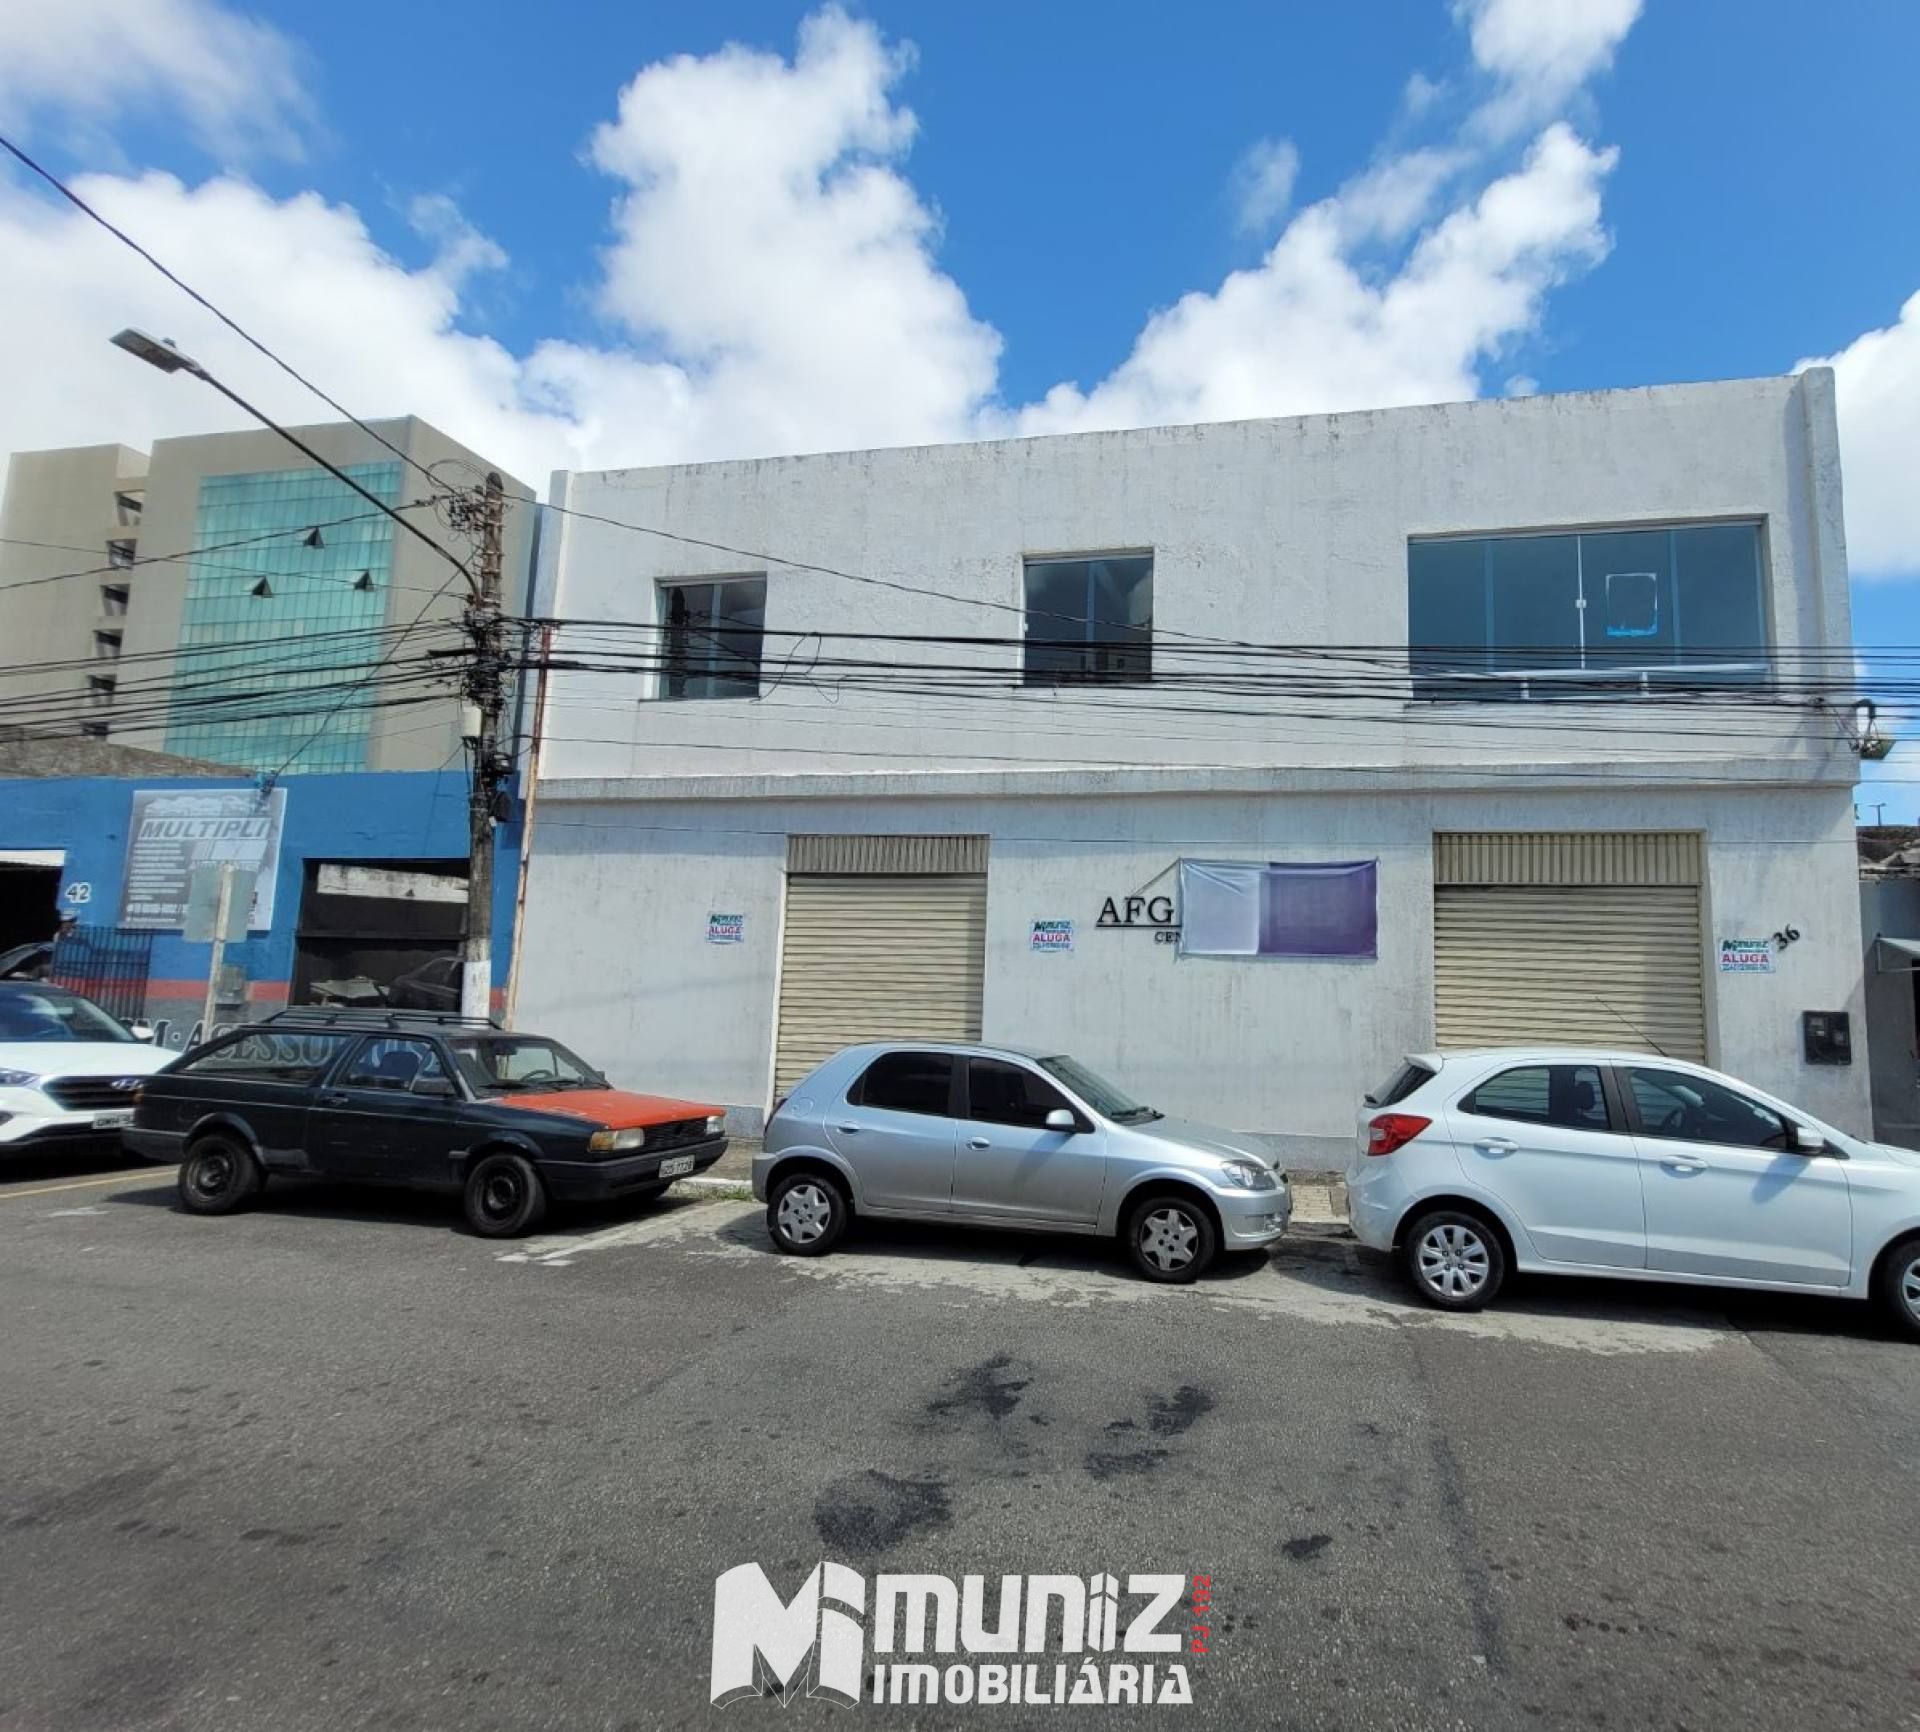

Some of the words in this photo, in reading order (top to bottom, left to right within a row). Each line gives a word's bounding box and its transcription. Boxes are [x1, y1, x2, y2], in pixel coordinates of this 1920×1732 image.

[66, 883, 91, 903] 42
[1096, 896, 1174, 923] AFG
[1773, 924, 1800, 951] 36
[1722, 953, 1768, 962] ALUGA
